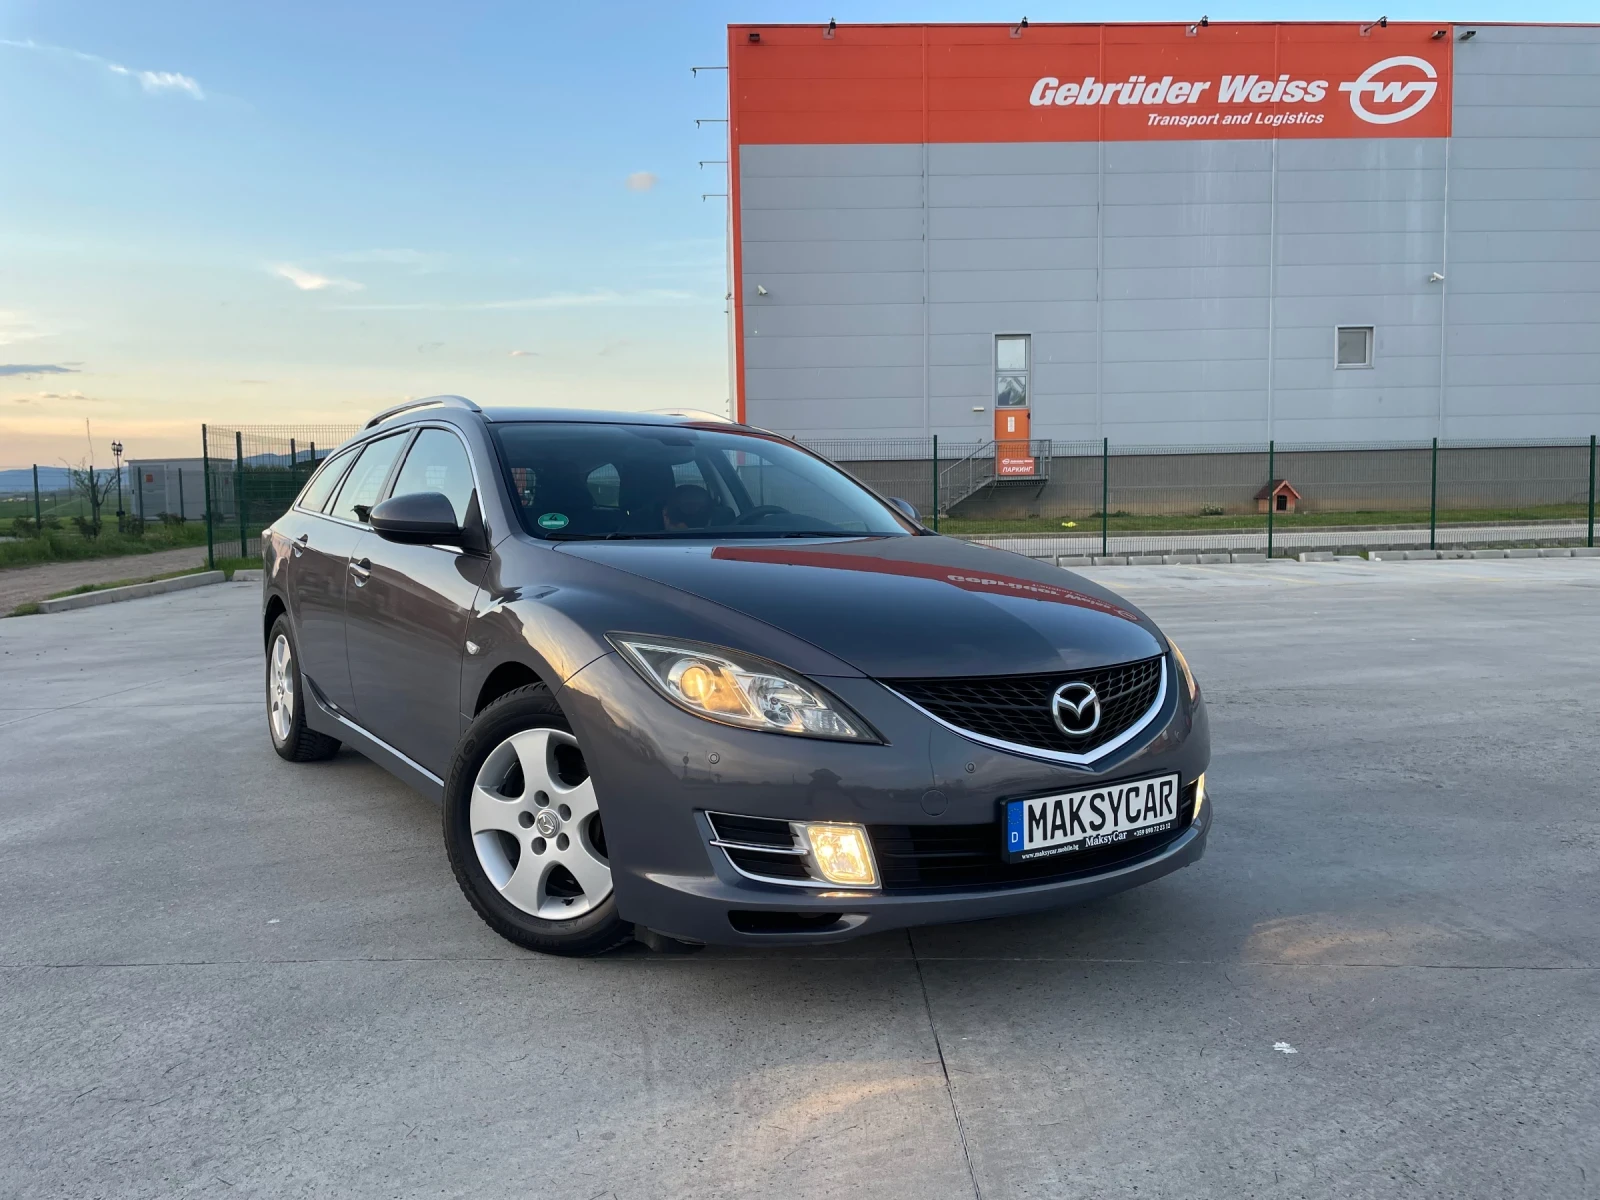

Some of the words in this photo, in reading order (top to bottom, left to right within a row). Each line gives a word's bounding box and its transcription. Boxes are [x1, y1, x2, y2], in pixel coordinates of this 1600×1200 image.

[1029, 75, 1210, 106] Gebrüder
[1217, 74, 1329, 103] Weiss
[1147, 112, 1220, 126] Transport
[1221, 112, 1250, 125] and
[1255, 111, 1324, 127] Logistics
[1028, 780, 1173, 843] MAKSYCAR
[1011, 832, 1019, 843] D
[1085, 831, 1127, 847] MaksyCar
